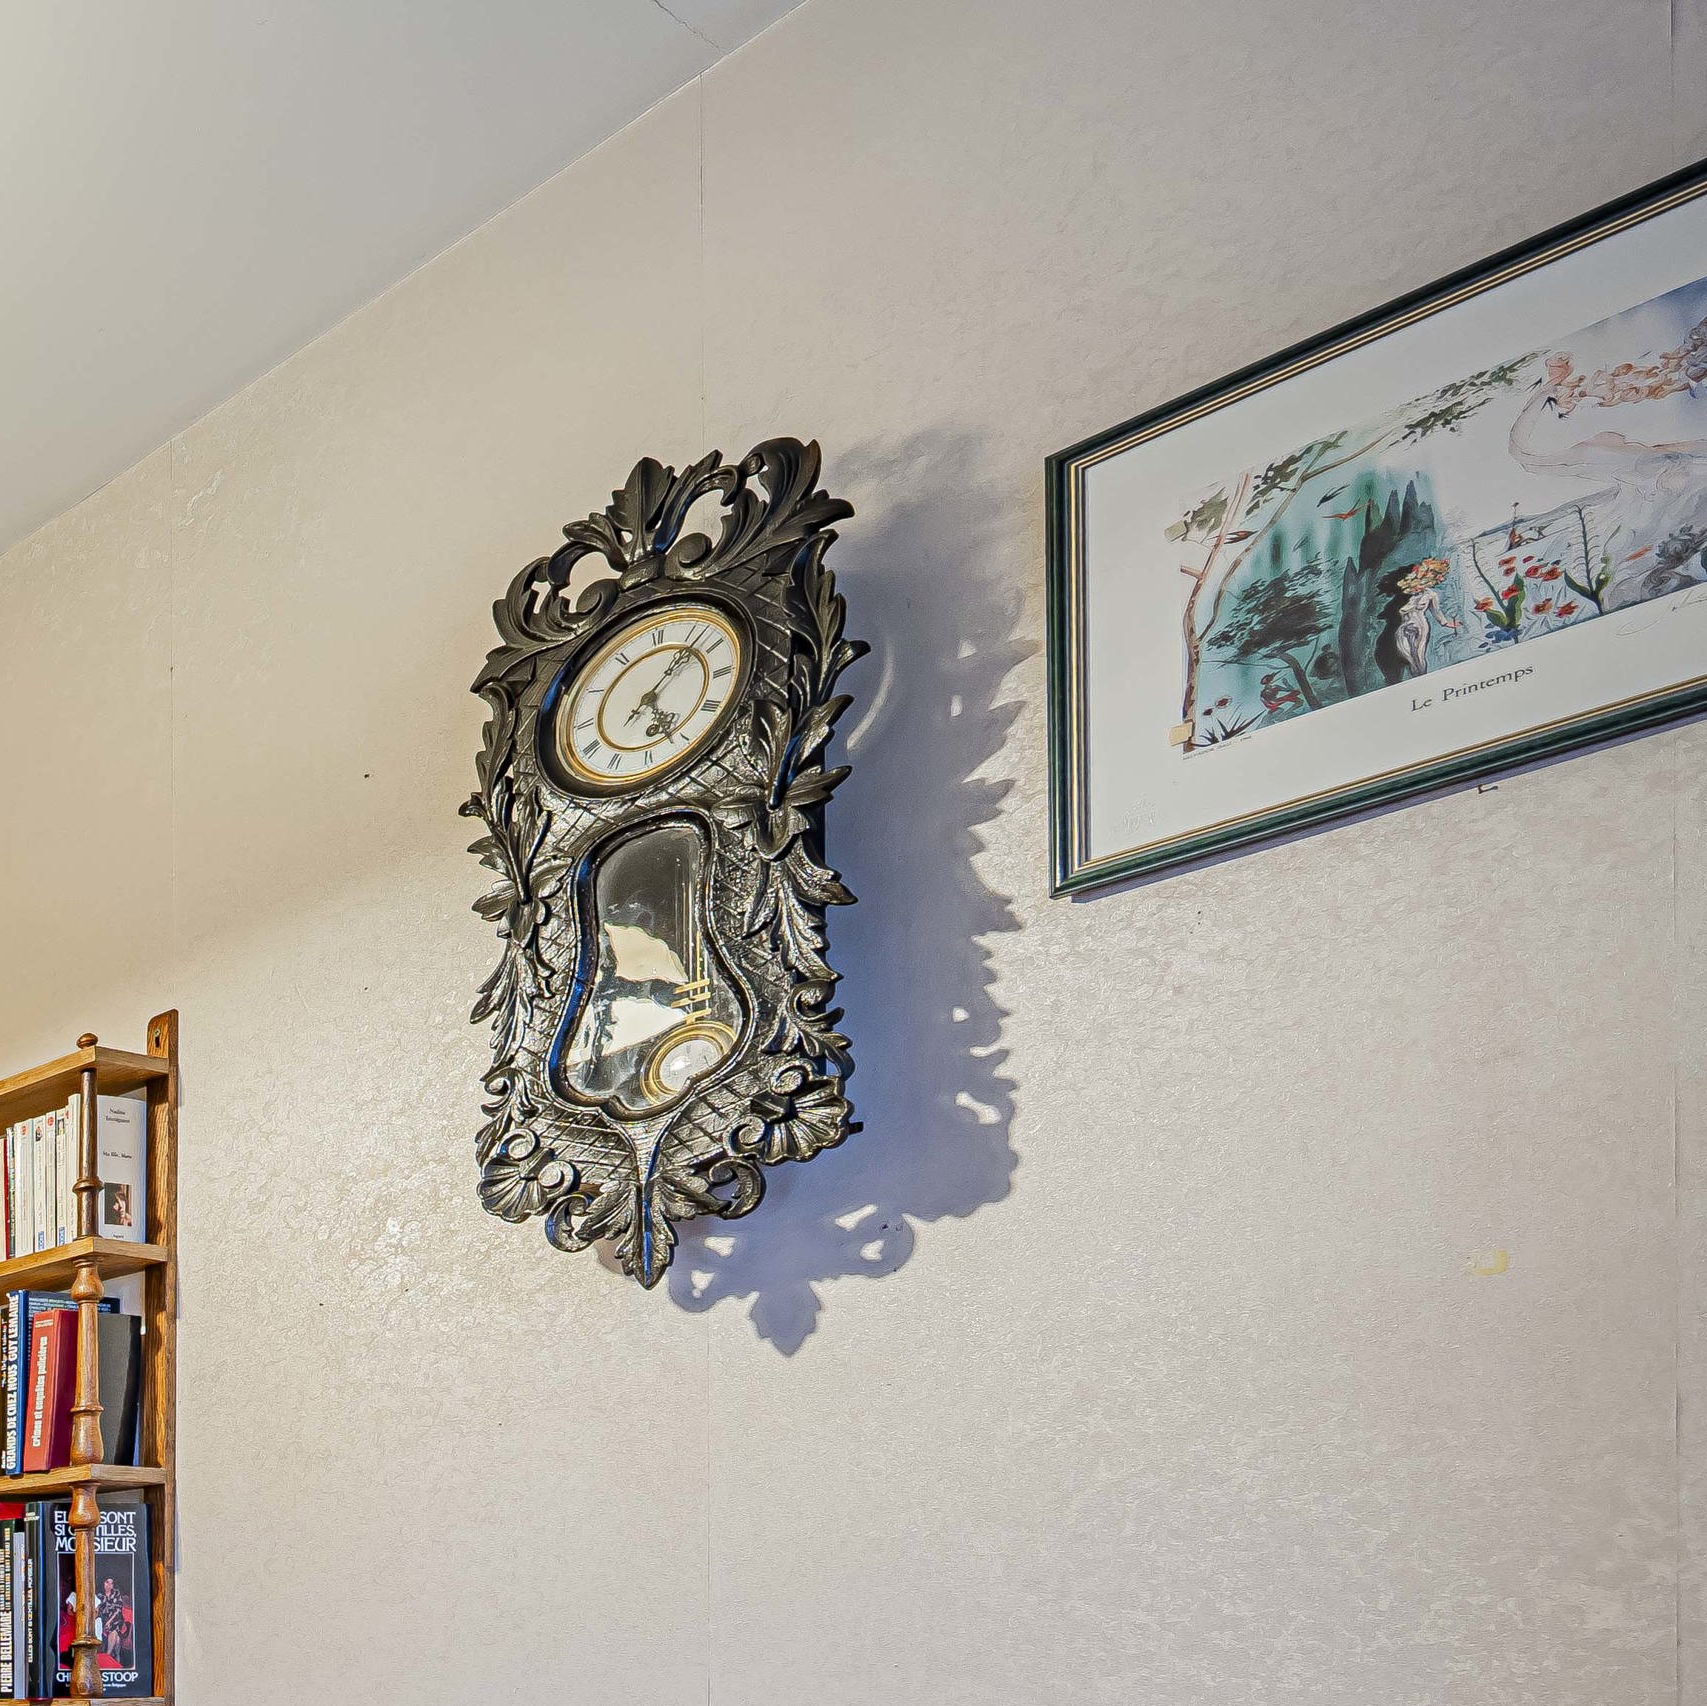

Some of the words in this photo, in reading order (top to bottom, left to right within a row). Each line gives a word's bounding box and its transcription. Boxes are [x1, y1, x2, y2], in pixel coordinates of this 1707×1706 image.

[1411, 699, 1432, 712] Le
[1442, 665, 1535, 702] Printemps
[8, 1295, 18, 1338] LEMAIRE
[8, 1340, 18, 1360] GUY
[7, 1364, 17, 1390] NOUS
[7, 1392, 17, 1414] CHEZ
[8, 1416, 17, 1427] DE
[7, 1430, 17, 1469] GRANDS
[55, 1537, 136, 1552] MOSIEUR
[0, 1611, 12, 1660] BELLEMARE
[0, 1663, 12, 1693] PIERRE
